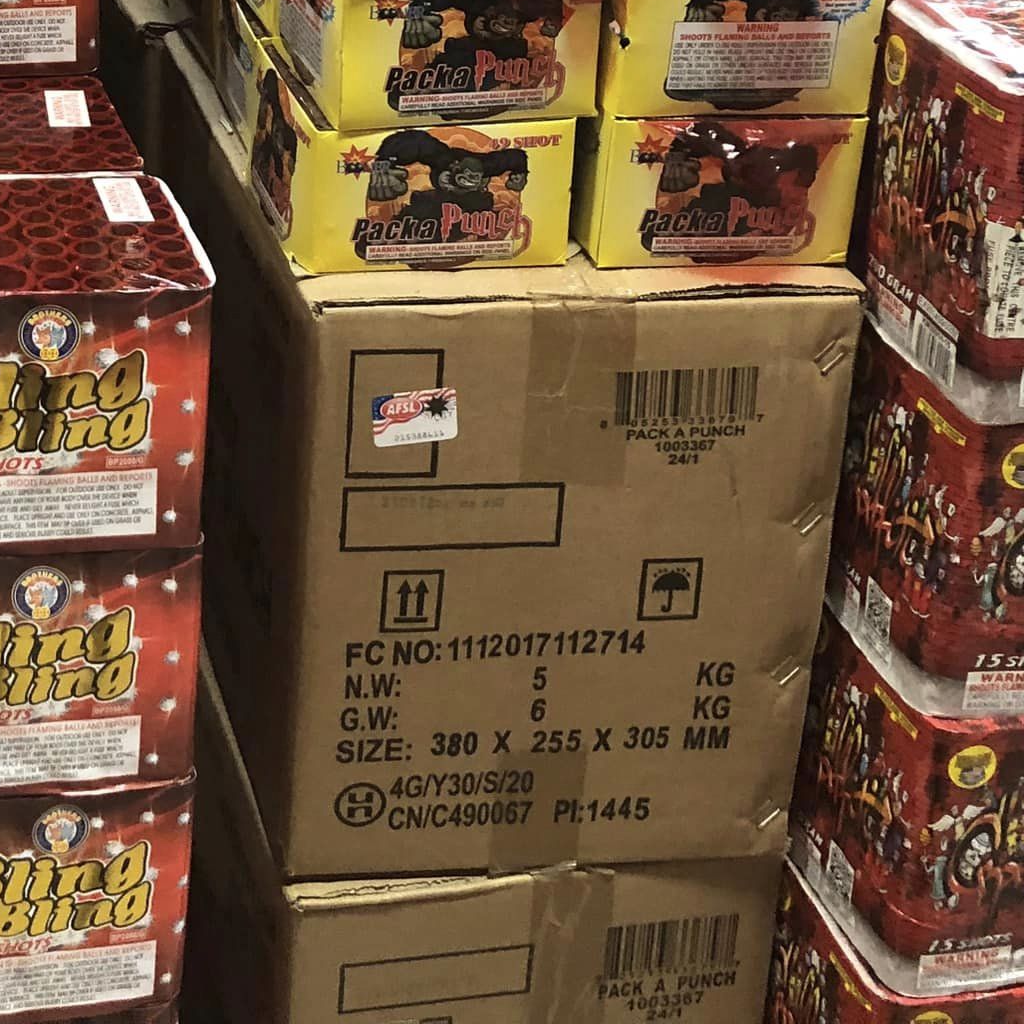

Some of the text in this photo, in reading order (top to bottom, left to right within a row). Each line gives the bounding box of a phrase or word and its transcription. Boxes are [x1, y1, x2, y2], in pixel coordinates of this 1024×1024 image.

[513, 134, 563, 149] SHOT
[386, 402, 417, 417] AFSL
[626, 425, 746, 441] PACK A PUNCH
[655, 439, 716, 452] 1003367
[667, 454, 700, 465] 24/1
[345, 642, 385, 668] FC
[447, 630, 646, 662] 1112017112714
[974, 653, 1005, 669] 15
[344, 662, 735, 699] N.W: 5 KG
[981, 672, 1024, 683] WARN
[339, 696, 731, 732] G.W: 6 KG
[336, 726, 731, 764] SIZE: 380 X 255 X 305 MM
[390, 771, 535, 800] 4G/Y30/S/20
[388, 800, 533, 830] CN/C490067
[597, 971, 737, 1000] PACK A PUNCH
